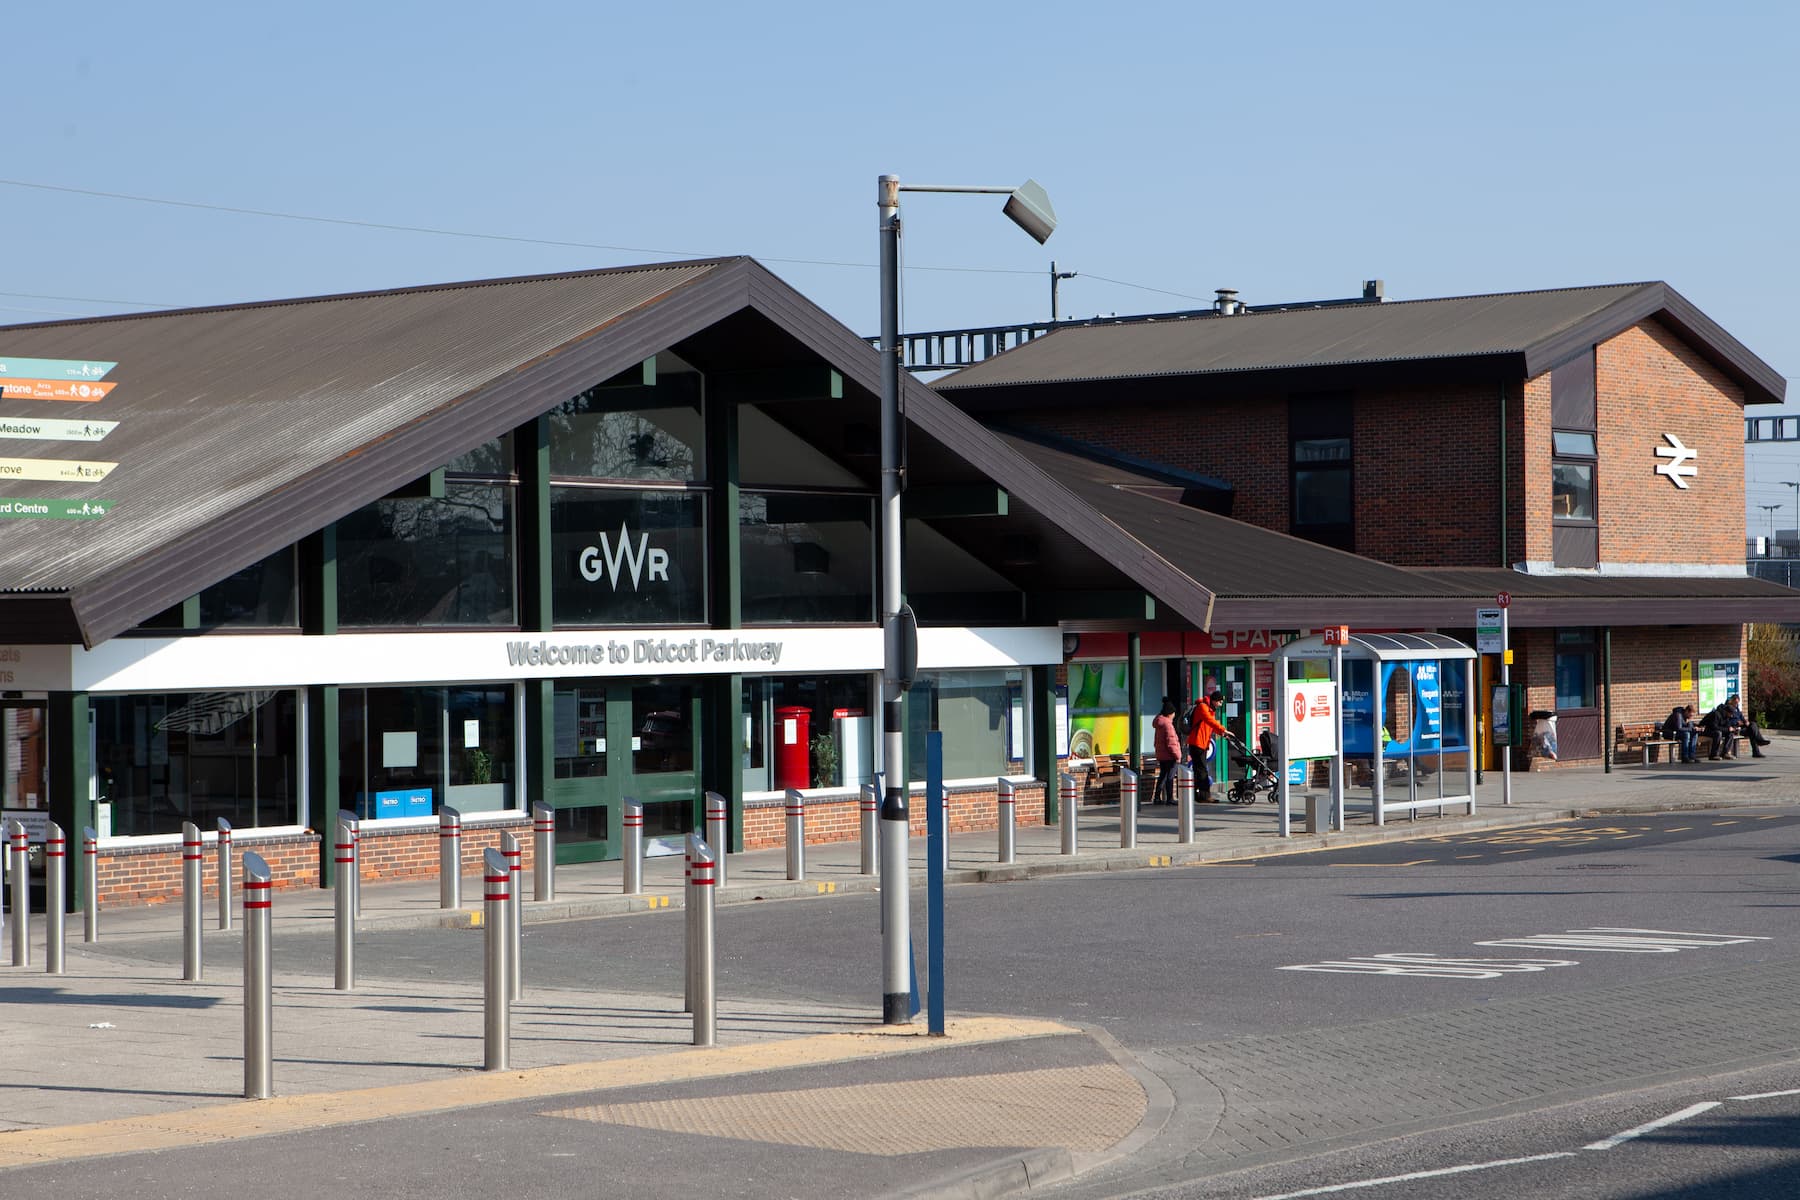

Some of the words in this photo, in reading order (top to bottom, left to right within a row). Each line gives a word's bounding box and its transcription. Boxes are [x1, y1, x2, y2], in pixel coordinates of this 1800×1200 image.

[14, 503, 48, 514] Centre
[579, 520, 669, 593] GWR
[1498, 594, 1510, 604] R1
[1325, 630, 1340, 641] R1
[1341, 629, 1349, 641] R1
[507, 640, 604, 668] Welcome
[608, 641, 629, 664] to
[633, 638, 699, 664] Didcot
[701, 637, 783, 666] Parkway
[1294, 700, 1305, 715] R1
[1473, 927, 1775, 953] ONLY
[1274, 952, 1580, 980] BUS
